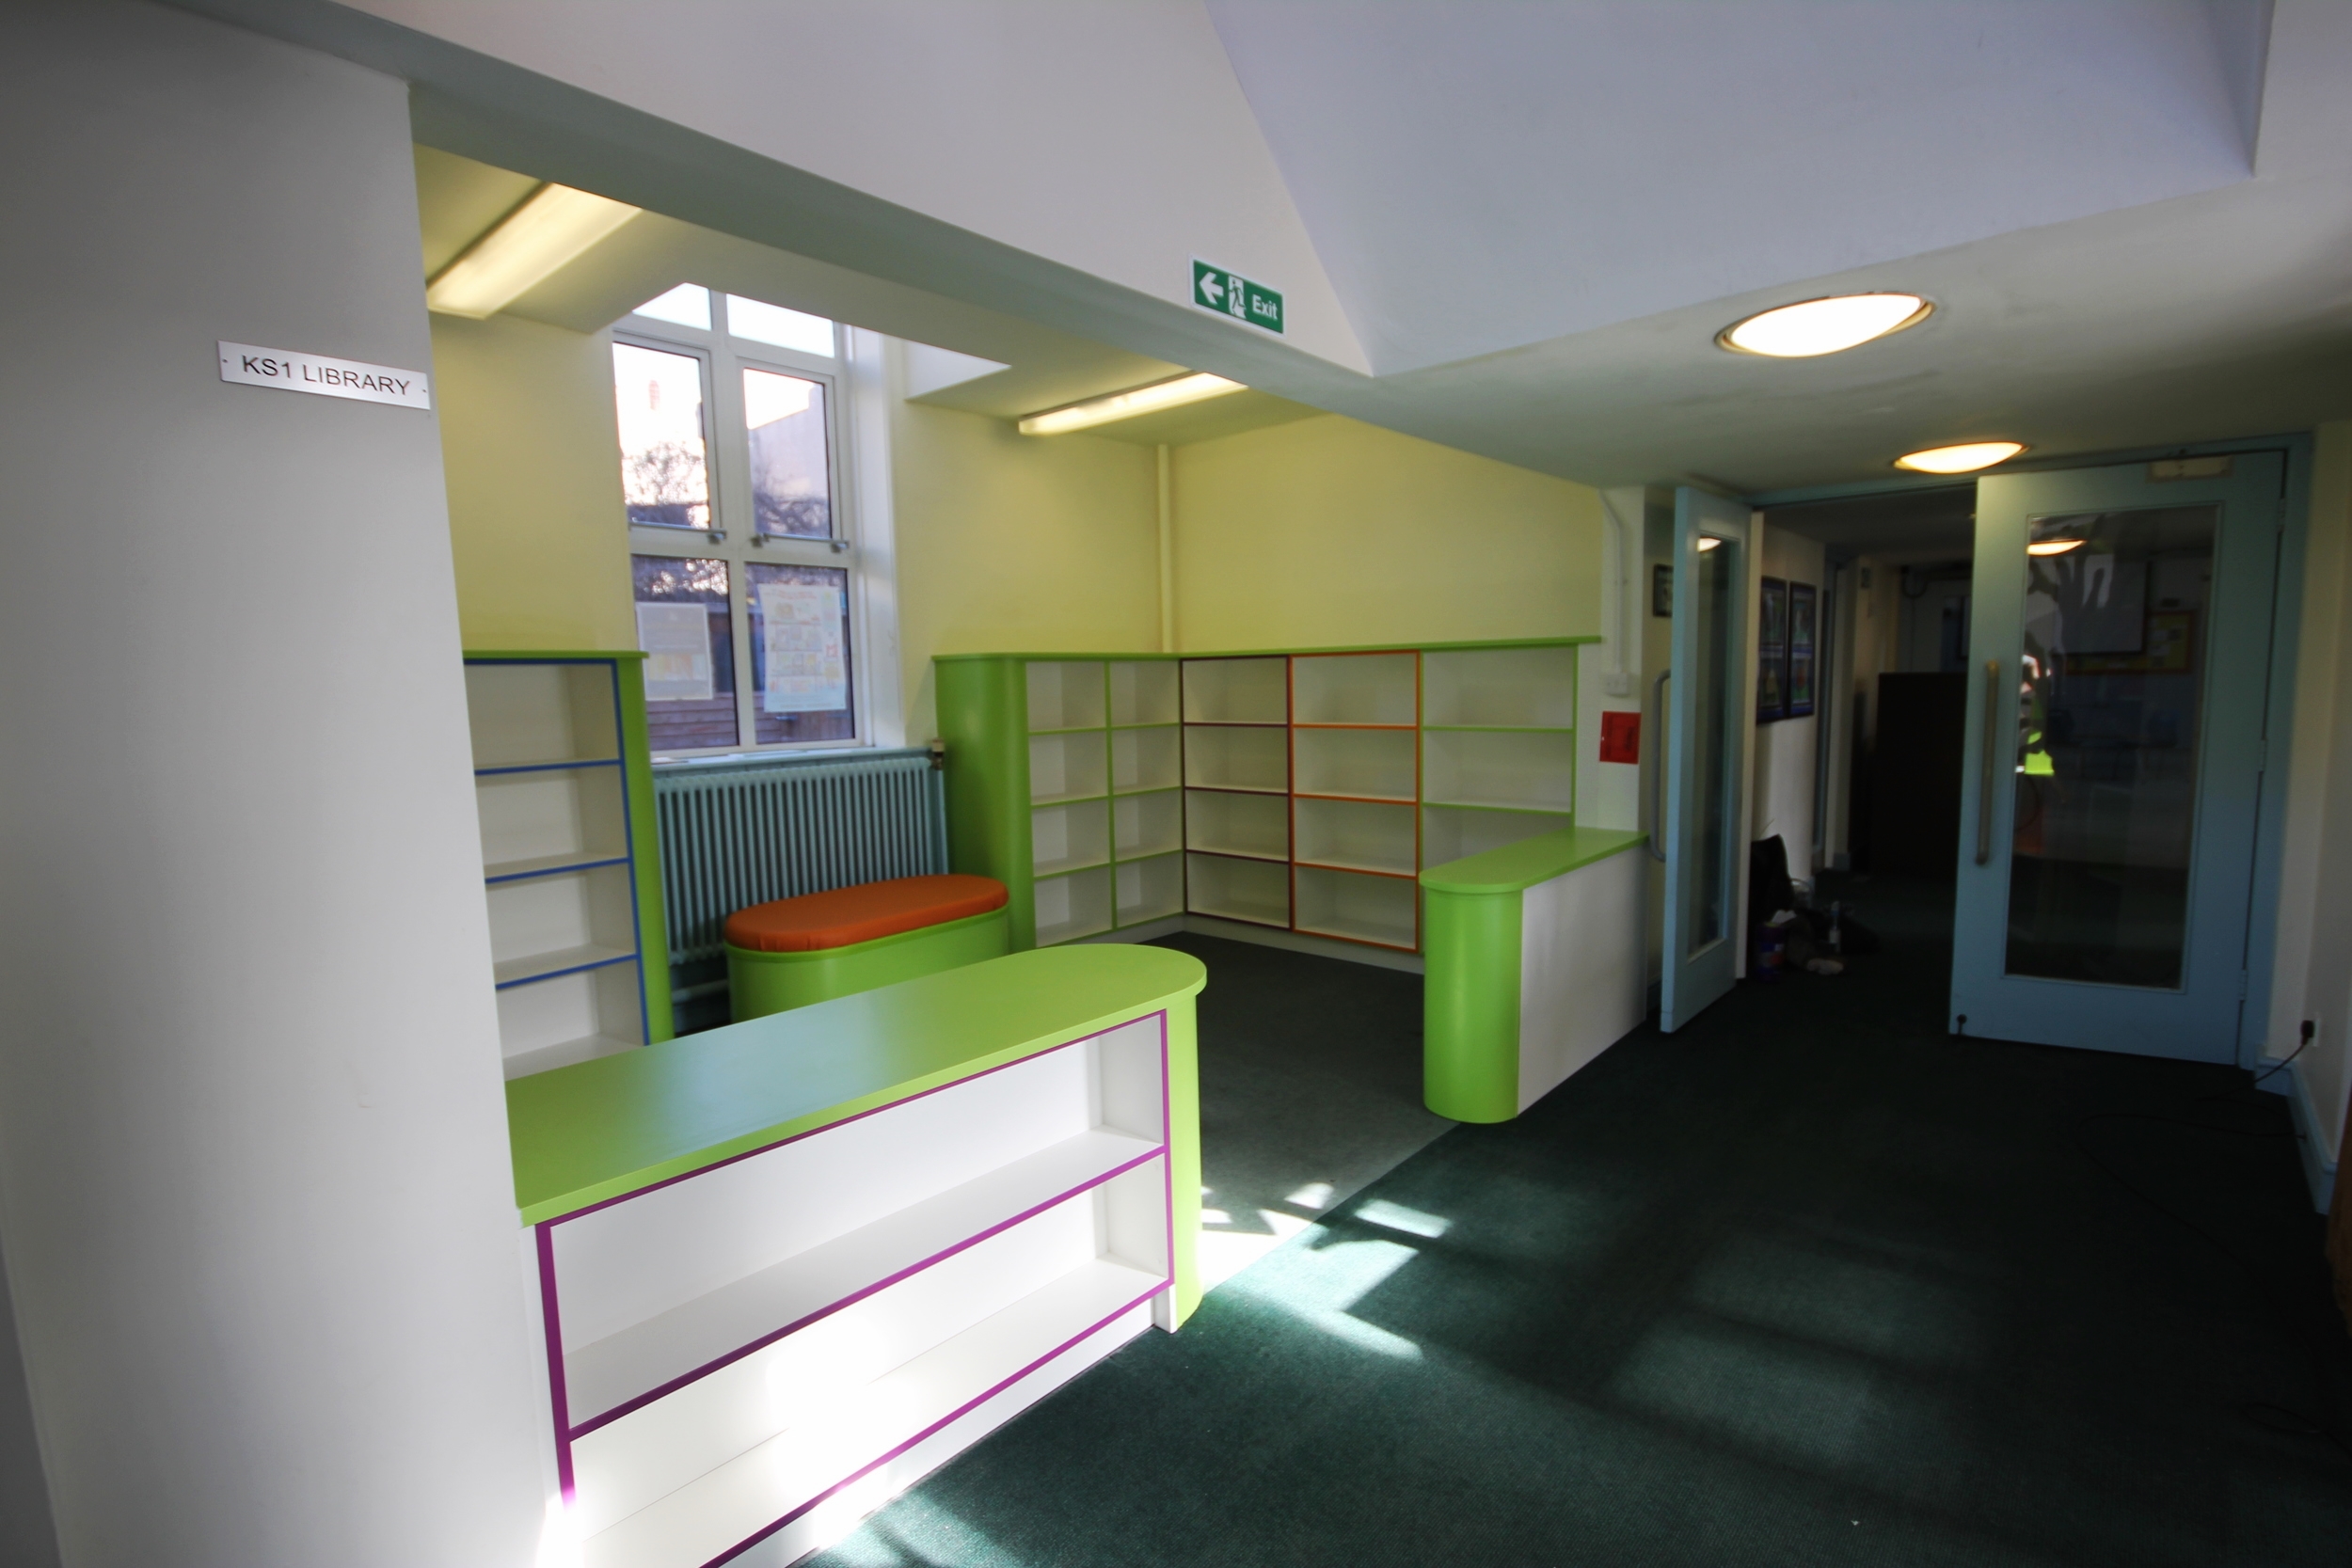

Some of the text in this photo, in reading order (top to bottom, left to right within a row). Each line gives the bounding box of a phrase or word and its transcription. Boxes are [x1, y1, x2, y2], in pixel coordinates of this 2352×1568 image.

[1252, 293, 1278, 320] Exit
[242, 355, 410, 395] KS1 LIBRARY
